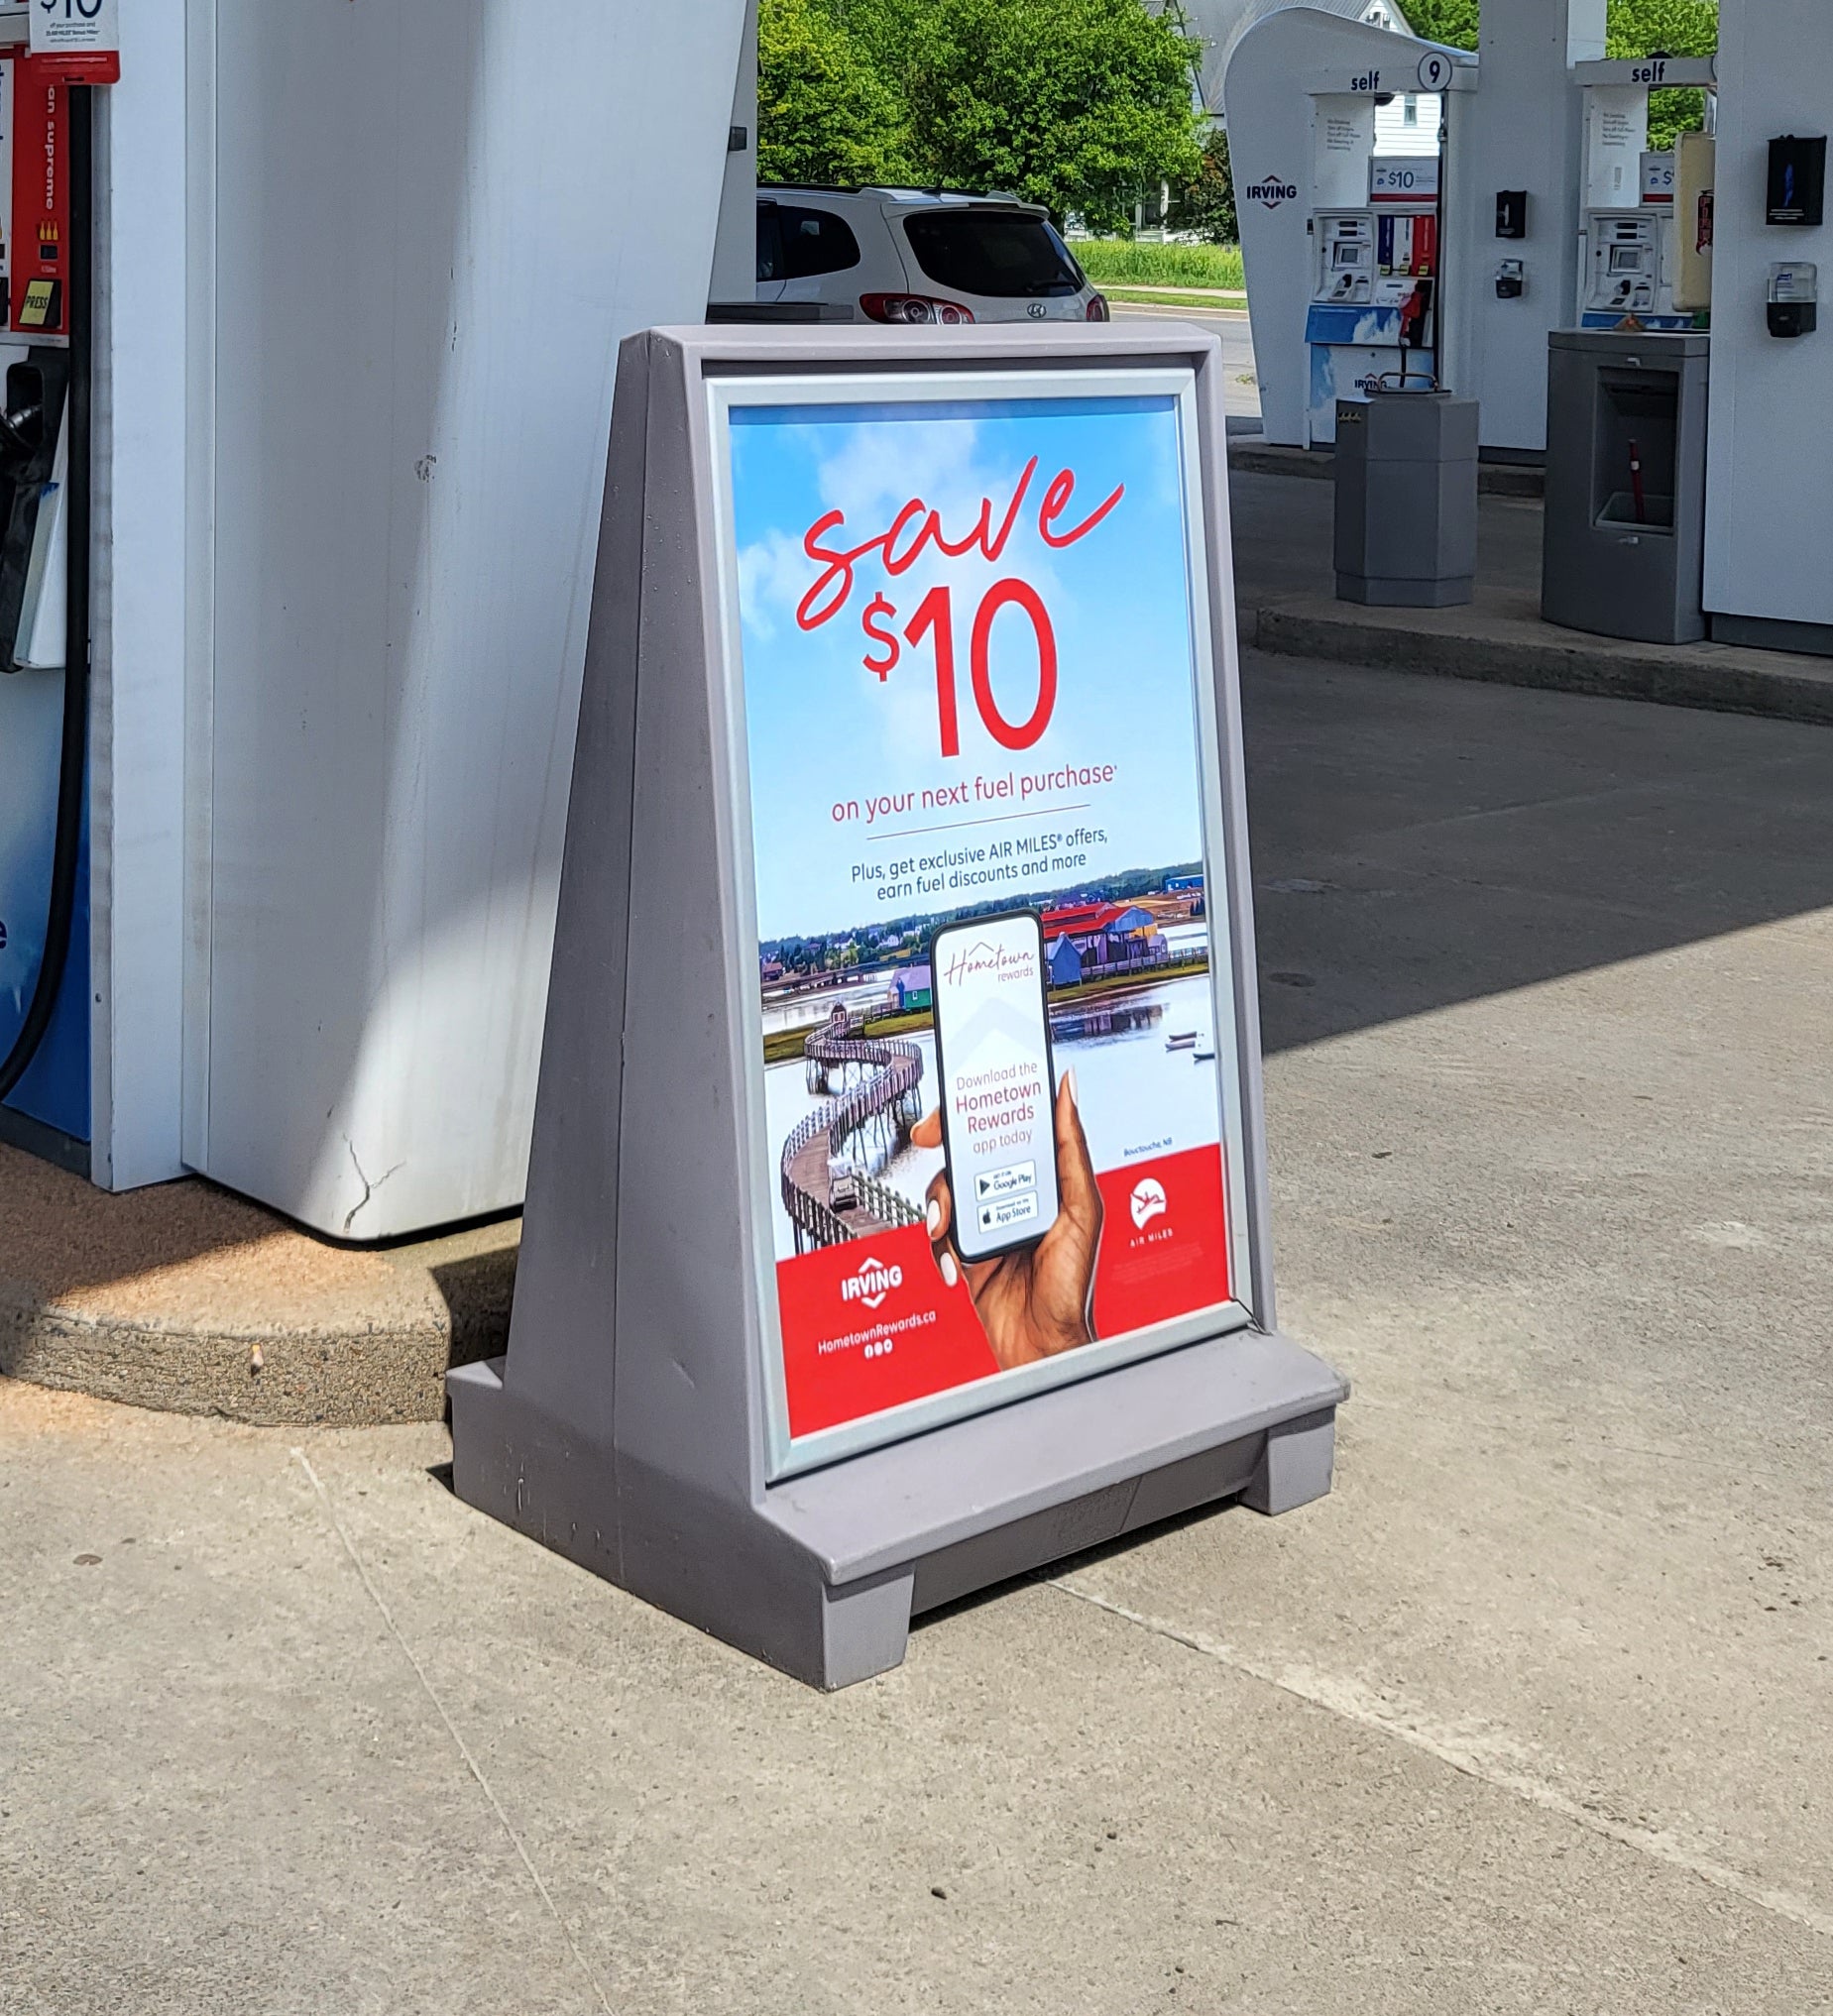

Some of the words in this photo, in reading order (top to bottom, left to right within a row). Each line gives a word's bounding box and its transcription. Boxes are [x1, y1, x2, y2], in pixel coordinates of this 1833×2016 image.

[1350, 69, 1380, 91] self
[1429, 59, 1440, 84] 9
[1631, 60, 1665, 83] self
[44, 121, 56, 210] supreme
[1388, 170, 1415, 188] $10
[1246, 184, 1298, 199] IRVING
[26, 295, 49, 309] PRESS
[796, 455, 1125, 630] save
[861, 578, 1057, 758] $10
[832, 801, 859, 822] on
[864, 792, 915, 824] your
[922, 782, 969, 809] next
[974, 772, 1014, 800] fuel
[852, 864, 886, 882] Plus,
[889, 857, 915, 878] get
[919, 846, 985, 872] exclusive
[989, 841, 1013, 860] AIR
[1066, 827, 1108, 847] offers,
[877, 882, 912, 900] earn
[916, 874, 945, 894] fuel
[949, 865, 1018, 889] discounts
[1021, 855, 1049, 875] and
[1052, 852, 1087, 869] more
[944, 943, 1035, 987] Hometown
[997, 966, 1034, 982] rewards
[957, 1064, 1017, 1091] Download
[1019, 1062, 1038, 1075] the
[956, 1080, 1042, 1114] Hometown
[967, 1102, 1035, 1134] Rewards
[973, 1138, 997, 1156] app
[999, 1129, 1033, 1146] today
[993, 1176, 1017, 1190] Google
[1018, 1174, 1032, 1184] Play
[996, 1210, 1011, 1223] App
[1012, 1205, 1031, 1217] Store
[1130, 1235, 1145, 1249] AIR
[1148, 1227, 1174, 1242] MILES
[841, 1265, 903, 1301] IRVING
[818, 1309, 937, 1355] HometownRewards.ca
